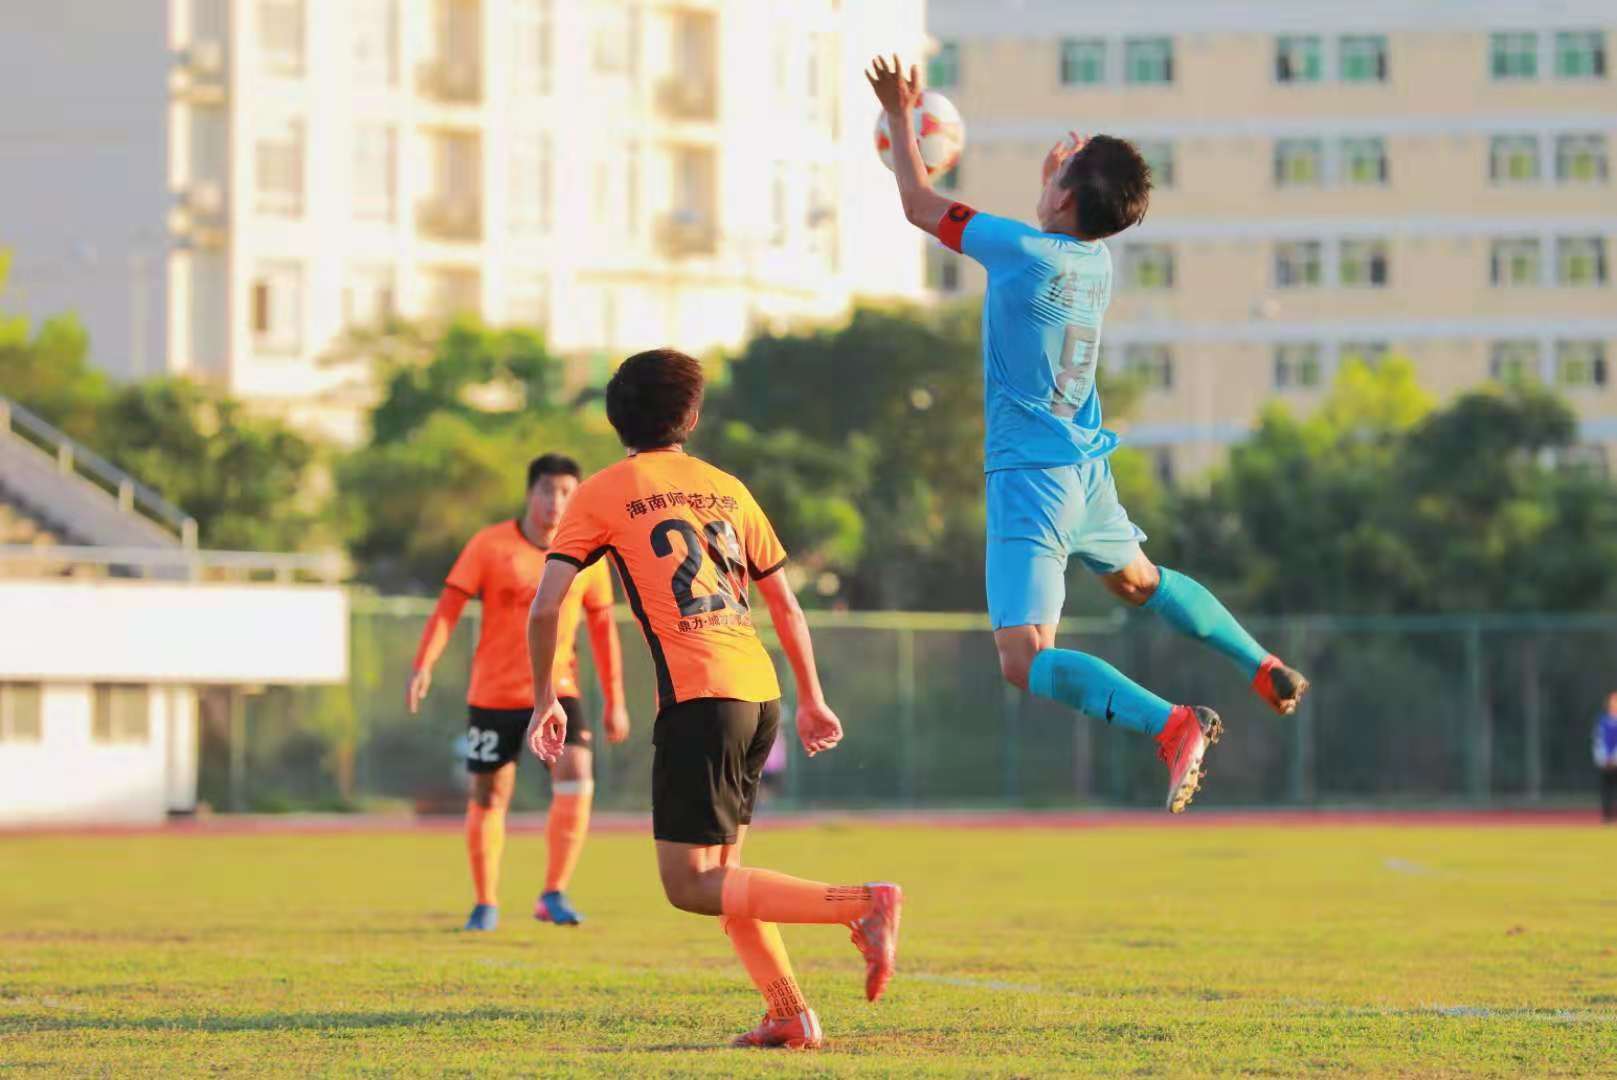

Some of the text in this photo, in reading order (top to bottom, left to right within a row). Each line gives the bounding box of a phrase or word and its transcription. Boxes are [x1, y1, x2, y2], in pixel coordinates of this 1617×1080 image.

[625, 491, 739, 519] 海南师范大学
[467, 726, 500, 763] 22
